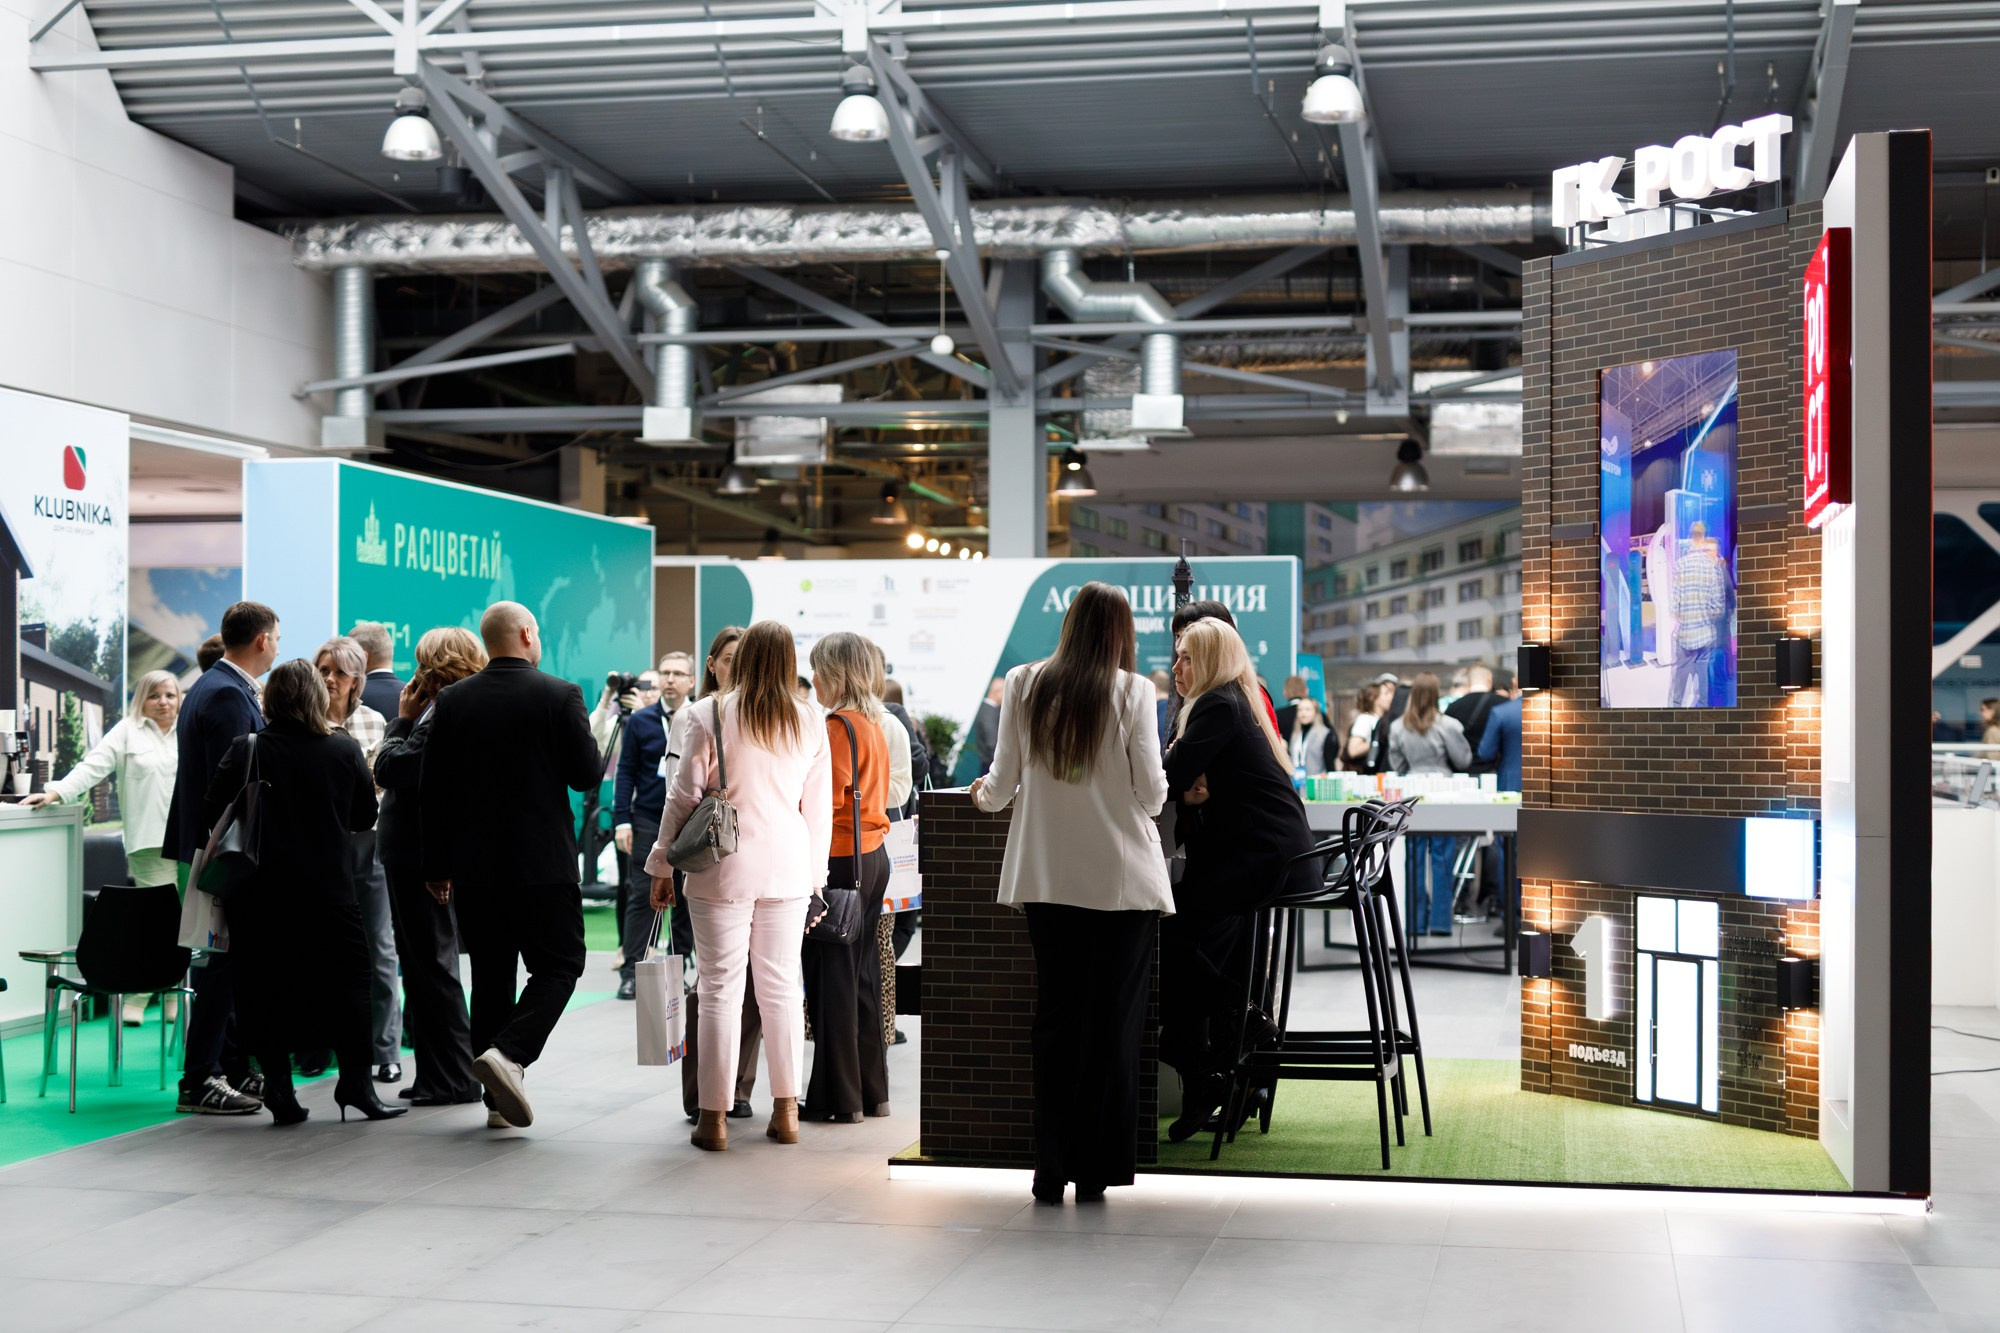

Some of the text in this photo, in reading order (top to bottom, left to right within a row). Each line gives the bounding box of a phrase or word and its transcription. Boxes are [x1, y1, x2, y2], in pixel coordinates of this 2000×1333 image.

[1552, 156, 1626, 228] ГК
[1634, 113, 1793, 209] РОСТ
[34, 494, 112, 526] KLUBNIKA
[394, 522, 502, 581] РАСЦВЕТАЙ
[1570, 916, 1612, 1020] 1
[1569, 1044, 1627, 1068] подъезд
